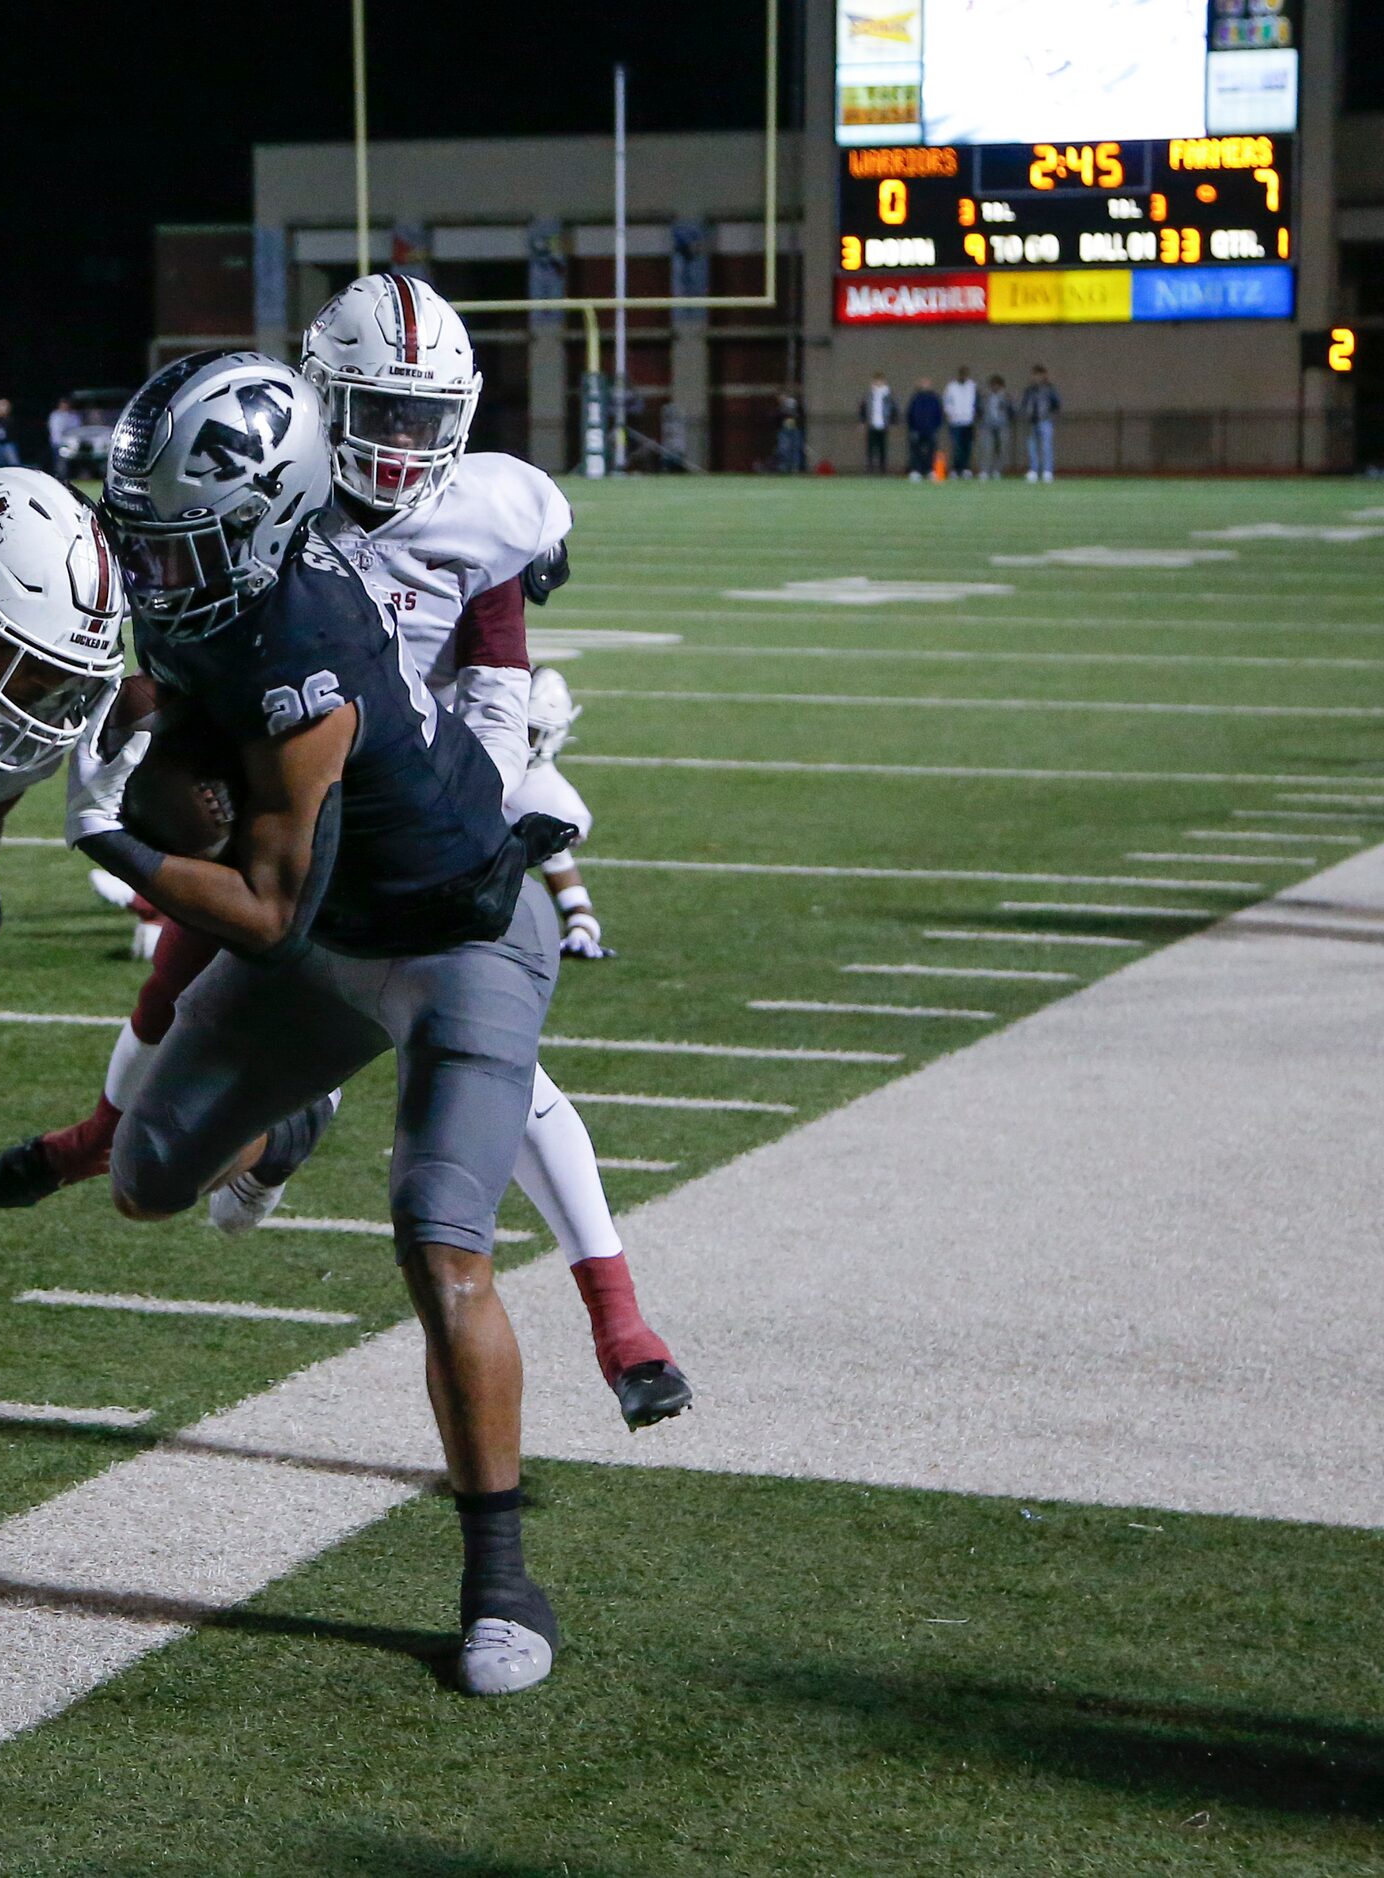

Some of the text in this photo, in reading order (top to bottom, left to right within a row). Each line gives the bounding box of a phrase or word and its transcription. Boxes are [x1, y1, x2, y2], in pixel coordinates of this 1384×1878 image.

[1029, 142, 1123, 188] 2:45
[878, 179, 907, 224] 0
[1148, 193, 1167, 222] 3
[1253, 168, 1280, 212] 7
[957, 198, 976, 226] 3
[841, 236, 862, 271] 3
[963, 233, 986, 266] 9
[1160, 227, 1201, 264] 33
[1277, 227, 1289, 260] 1
[1328, 328, 1355, 371] 2
[388, 365, 434, 380] LOCKED IN
[69, 632, 110, 650] LOCKED IN
[261, 669, 346, 737] 26
